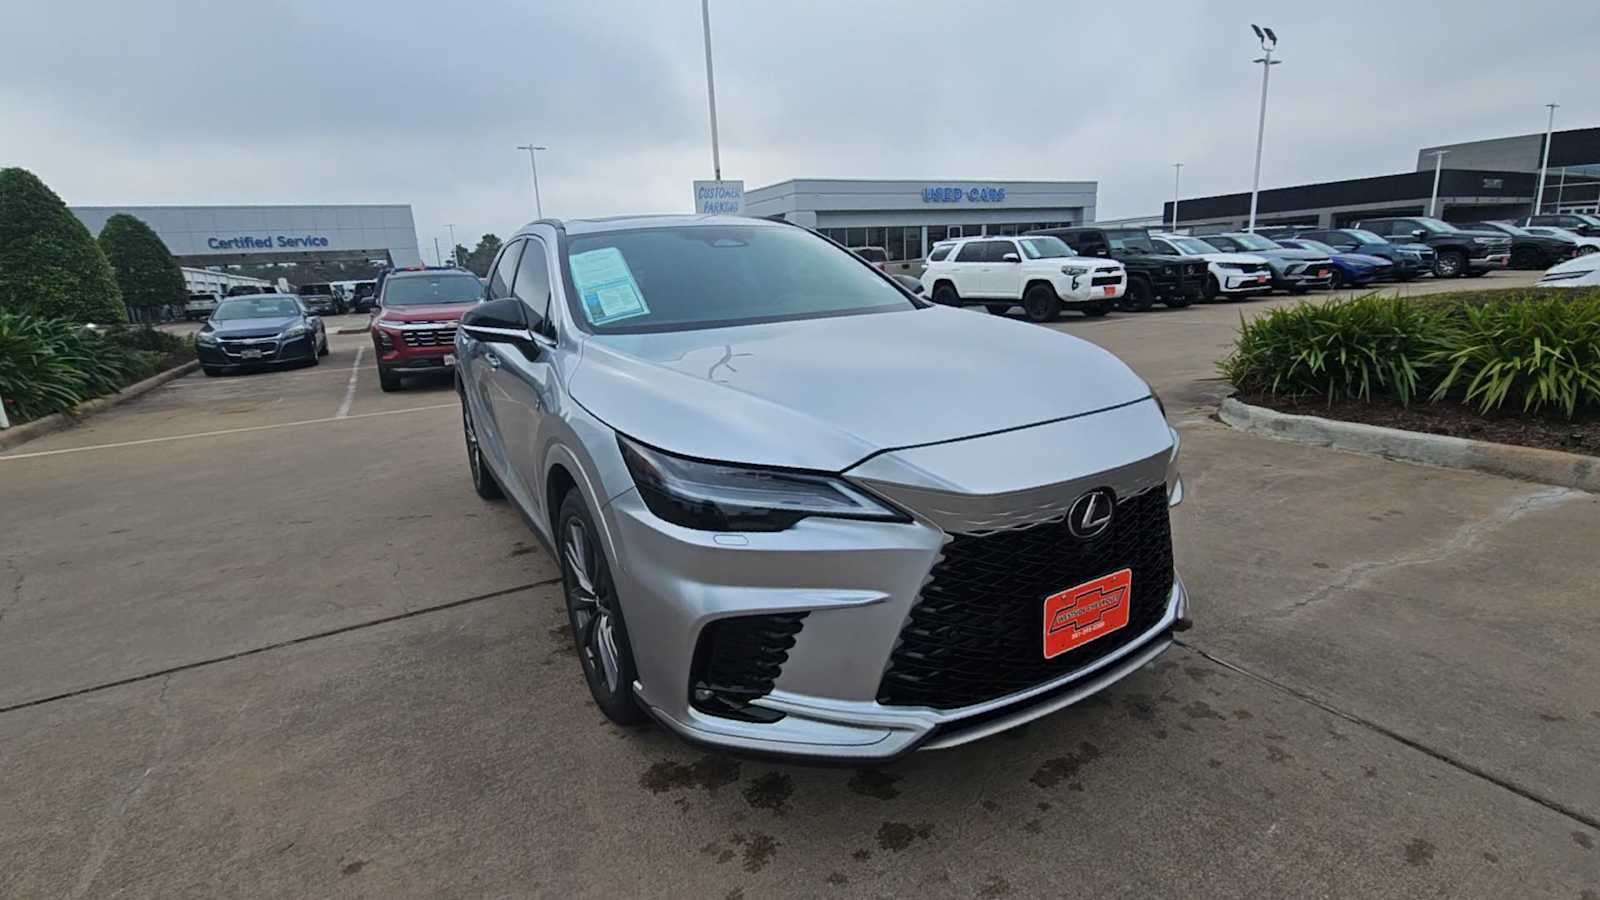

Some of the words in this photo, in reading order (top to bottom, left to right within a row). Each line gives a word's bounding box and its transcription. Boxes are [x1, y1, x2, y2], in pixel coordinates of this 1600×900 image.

[921, 187, 962, 203] USED
[967, 187, 1006, 203] CARS
[208, 235, 273, 249] Certified
[277, 235, 329, 248] Service
